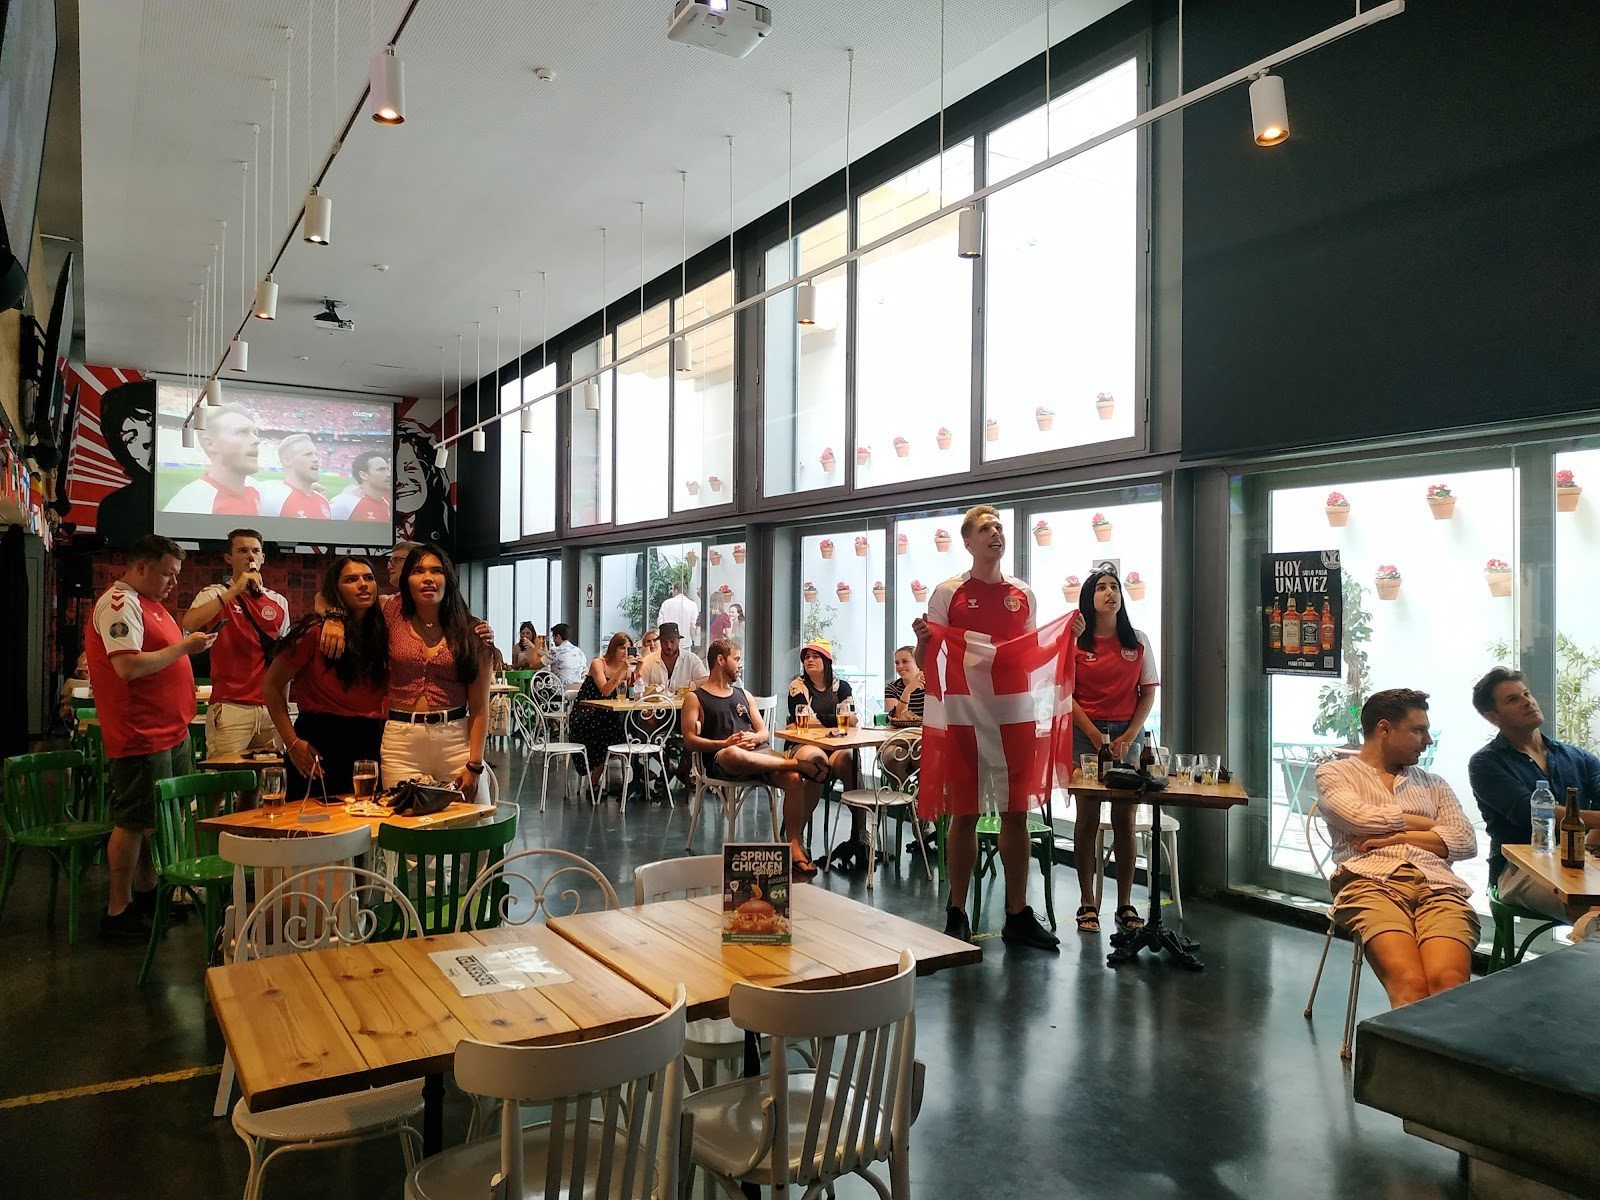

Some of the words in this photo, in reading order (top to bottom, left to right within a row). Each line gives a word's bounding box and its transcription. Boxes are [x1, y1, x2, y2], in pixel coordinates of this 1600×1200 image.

[1274, 561, 1301, 576] HOY
[1275, 576, 1302, 594] UNA
[1304, 576, 1328, 592] VEZ
[740, 850, 782, 861] SPRING
[732, 862, 782, 872] CHICKEN
[770, 890, 786, 900] €11
